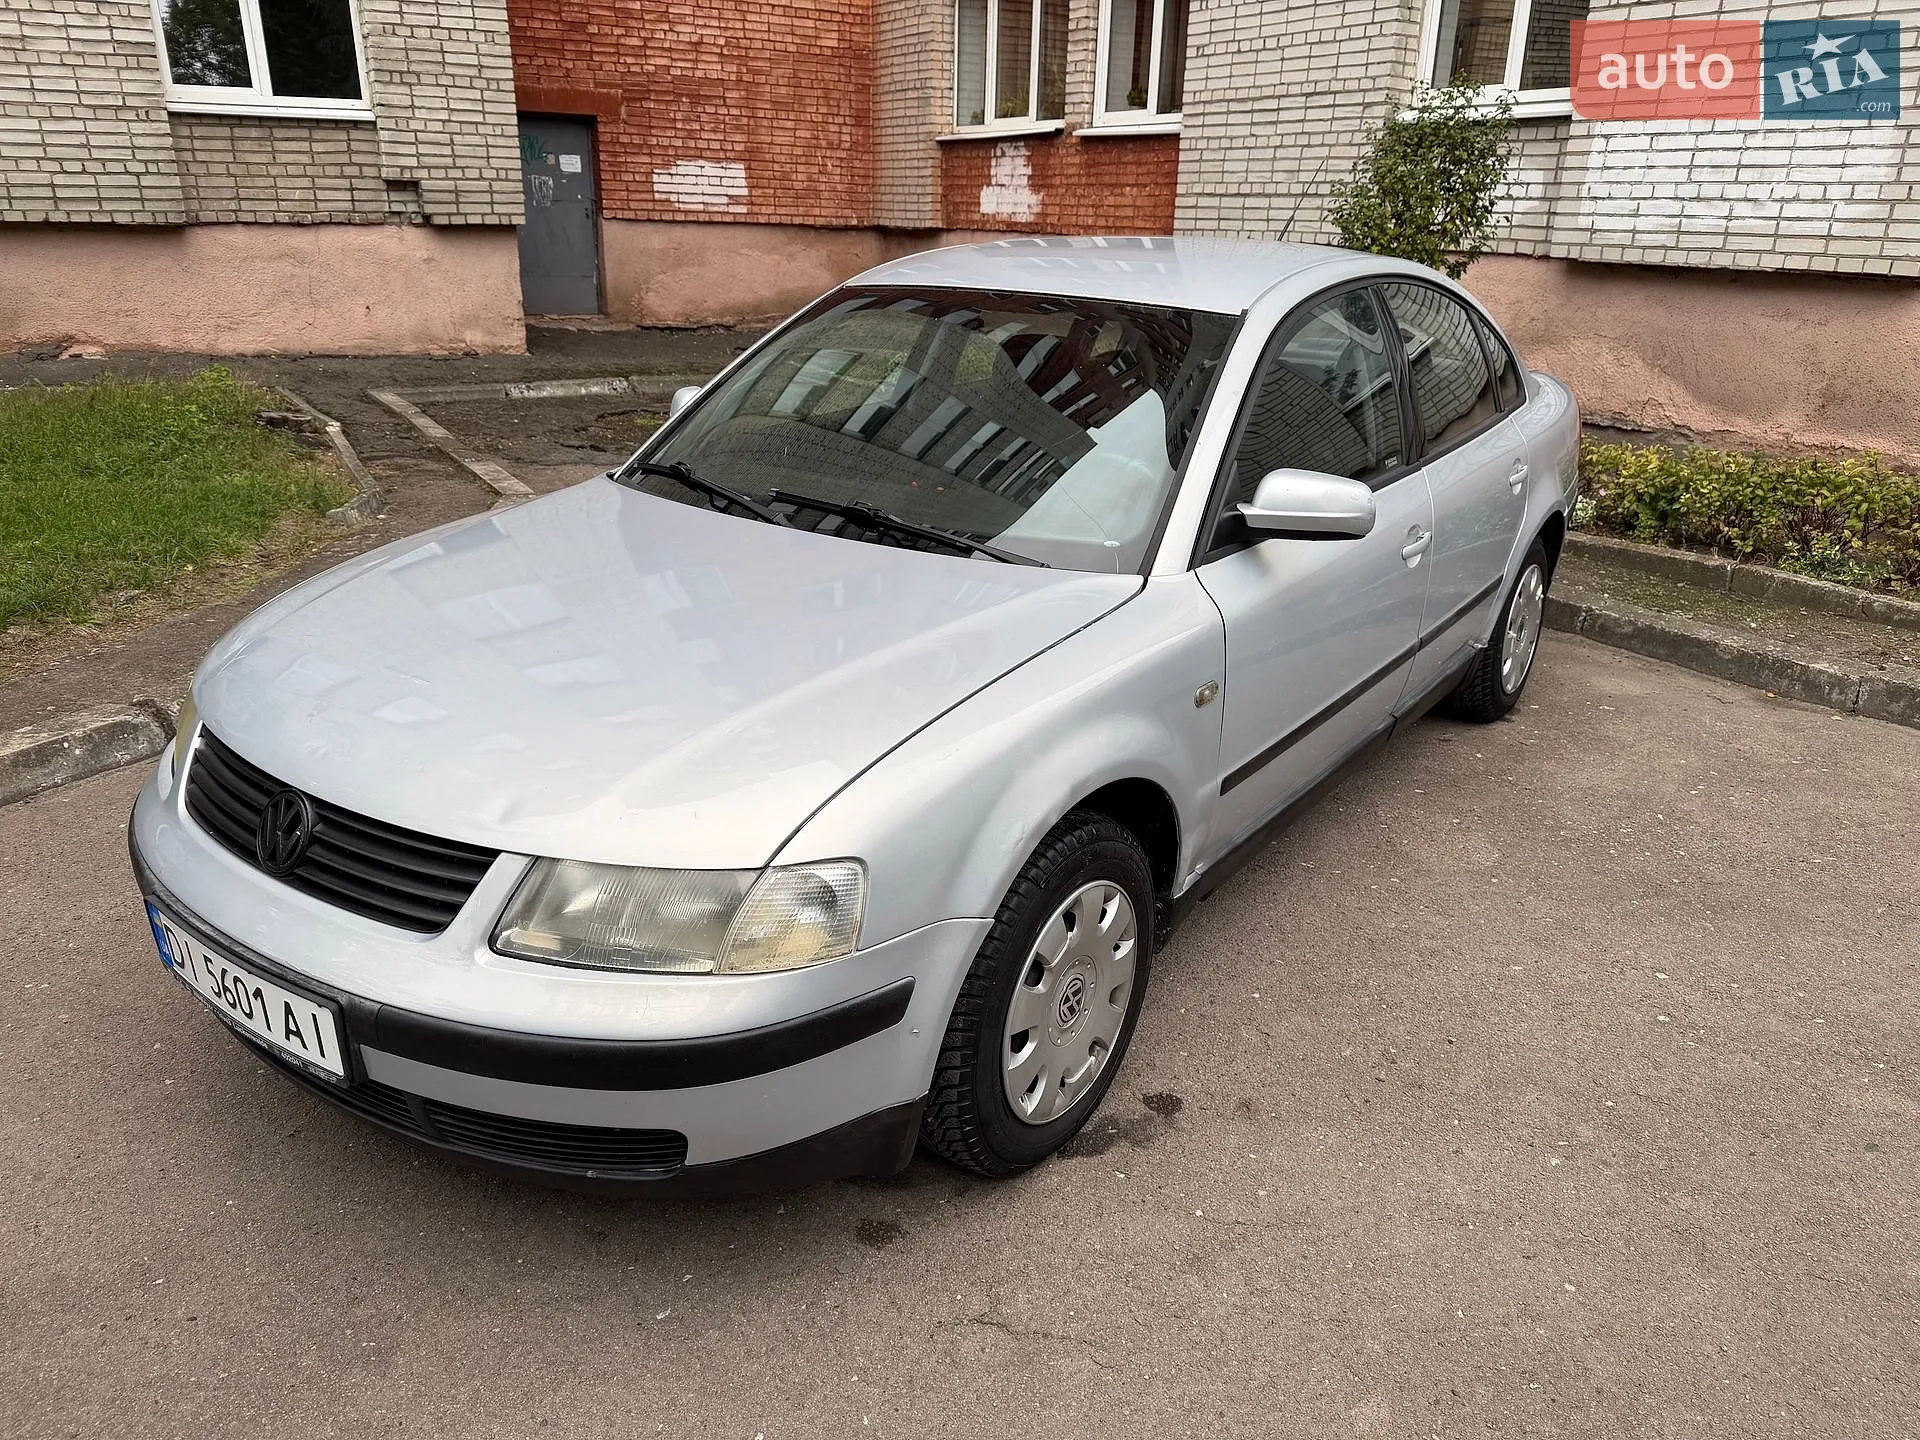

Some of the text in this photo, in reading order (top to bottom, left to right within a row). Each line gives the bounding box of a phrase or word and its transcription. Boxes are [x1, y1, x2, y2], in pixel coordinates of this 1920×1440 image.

[164, 922, 199, 983] DI
[202, 953, 272, 1032] 5601
[284, 1000, 326, 1059] AI
